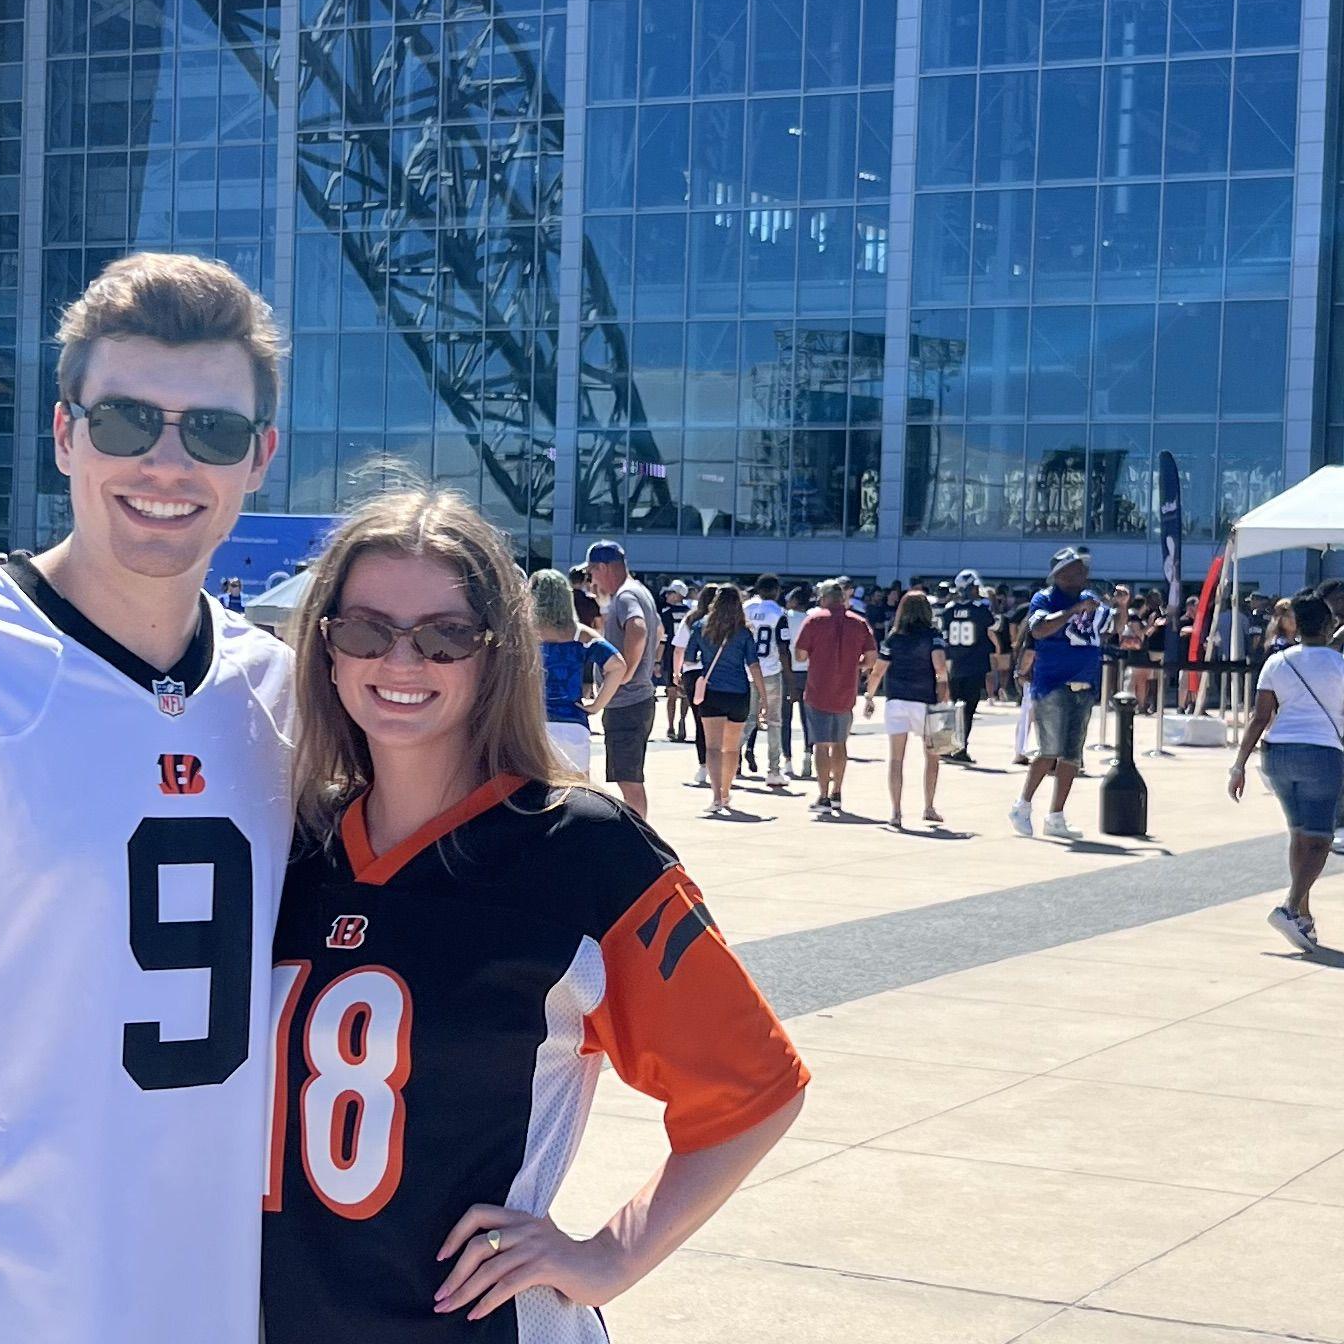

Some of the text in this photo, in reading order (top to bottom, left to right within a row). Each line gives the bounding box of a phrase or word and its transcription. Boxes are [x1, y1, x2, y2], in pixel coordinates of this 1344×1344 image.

[949, 620, 975, 646] 88
[162, 695, 184, 712] NFL
[123, 817, 252, 1091] 9
